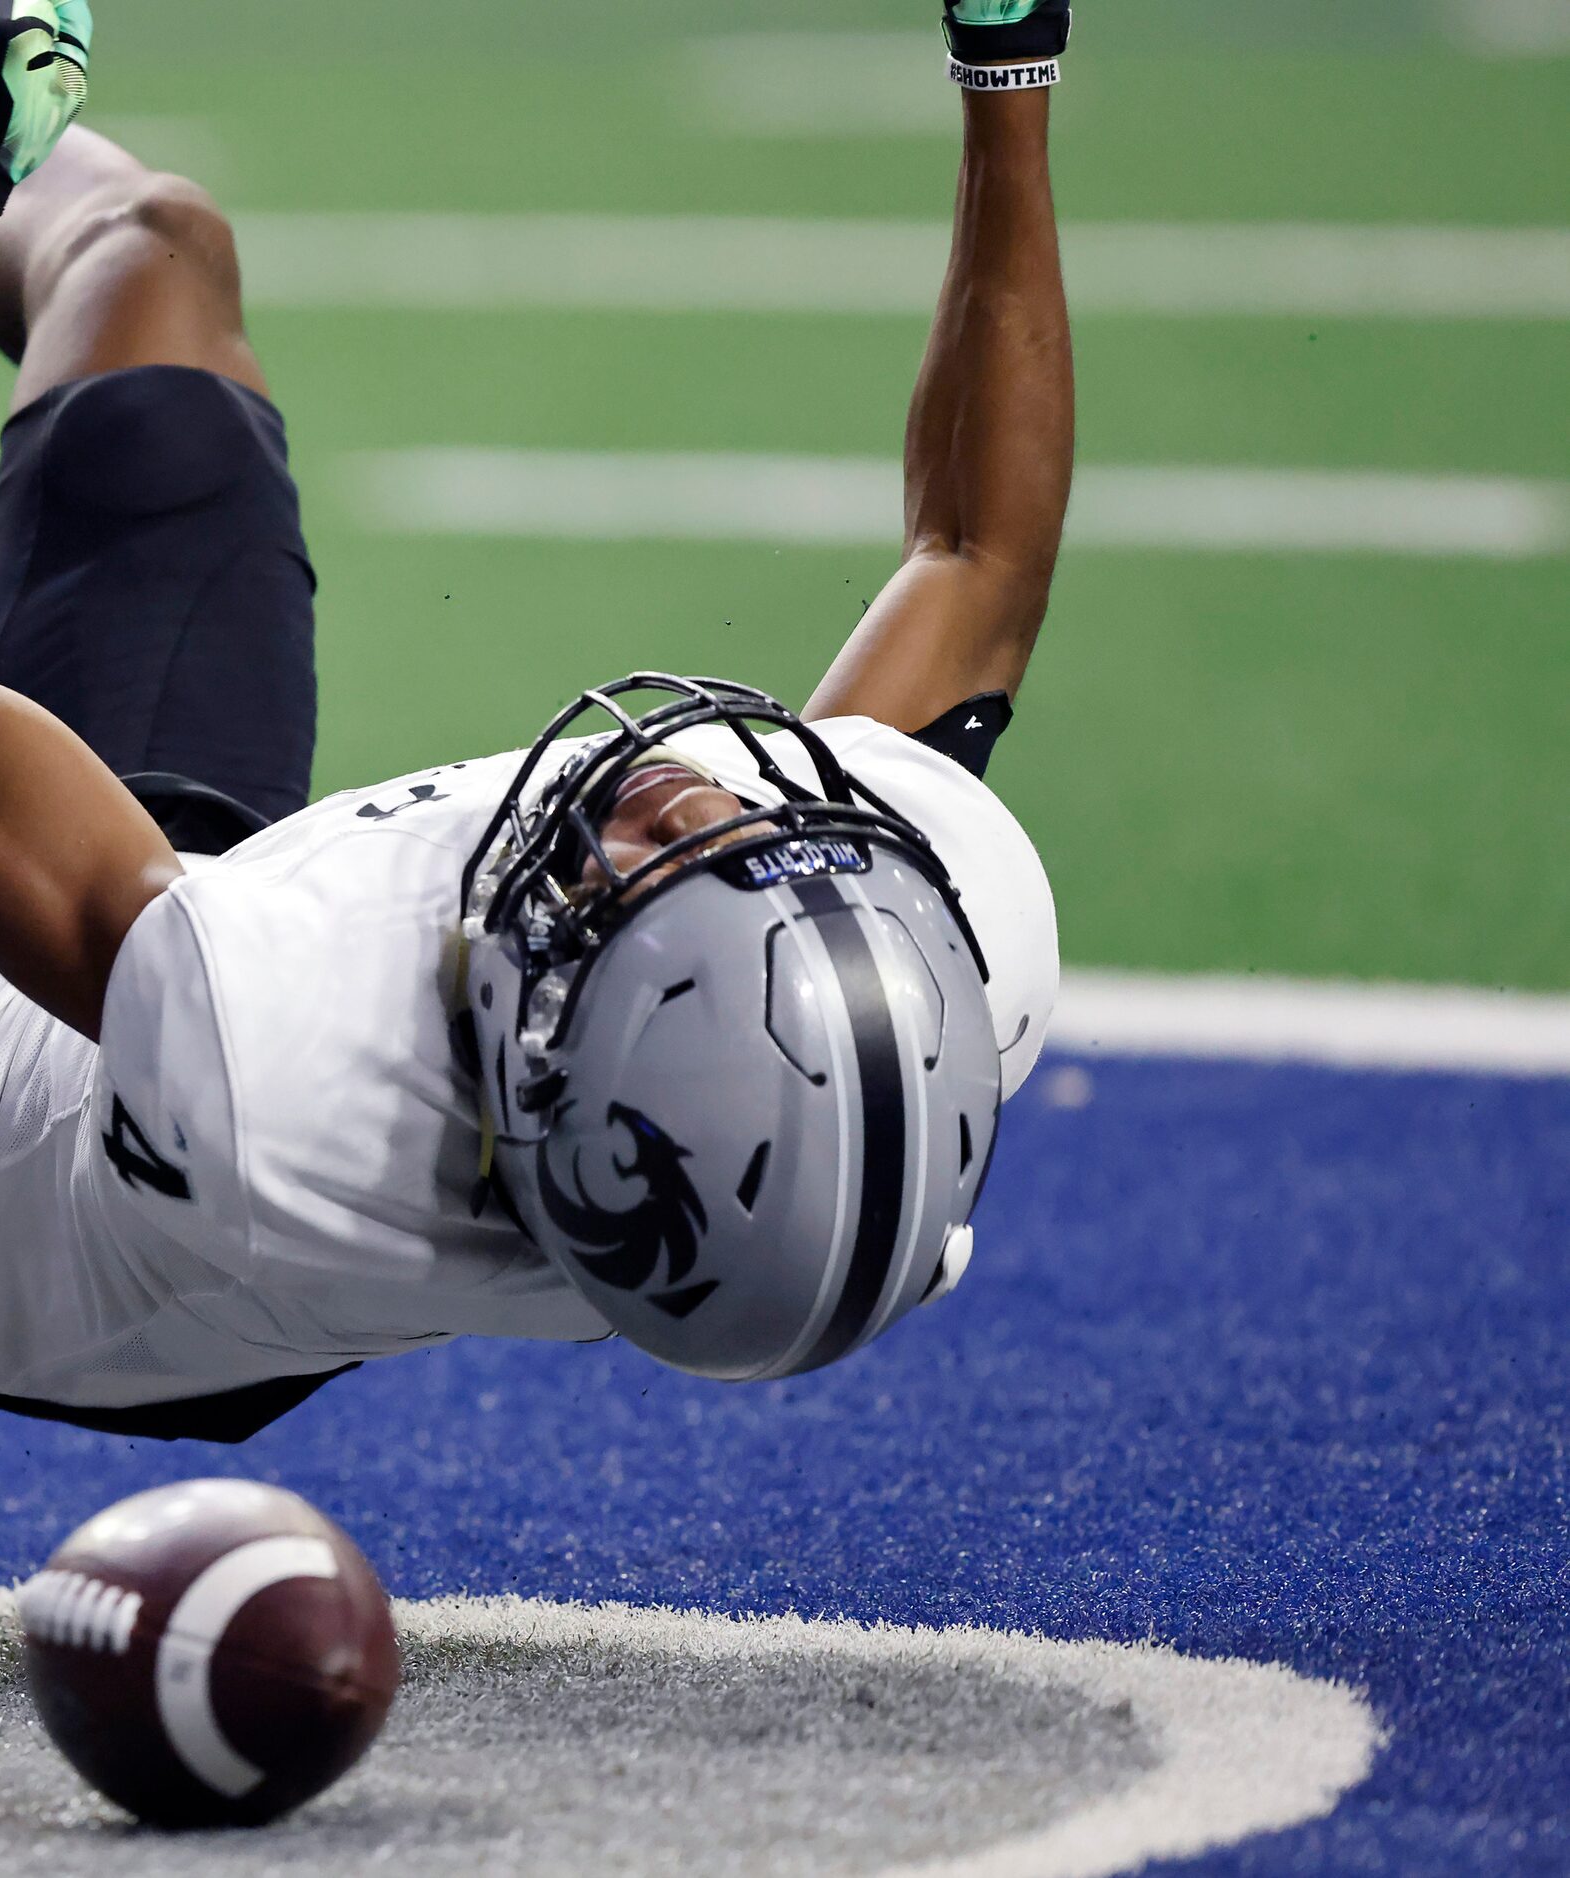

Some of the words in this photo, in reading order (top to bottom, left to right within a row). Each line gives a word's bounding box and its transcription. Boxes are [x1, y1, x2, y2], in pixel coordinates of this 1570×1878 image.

[950, 62, 1057, 88] #SHOWTIME
[745, 842, 862, 880] WILDCATS
[102, 1091, 193, 1201] 4
